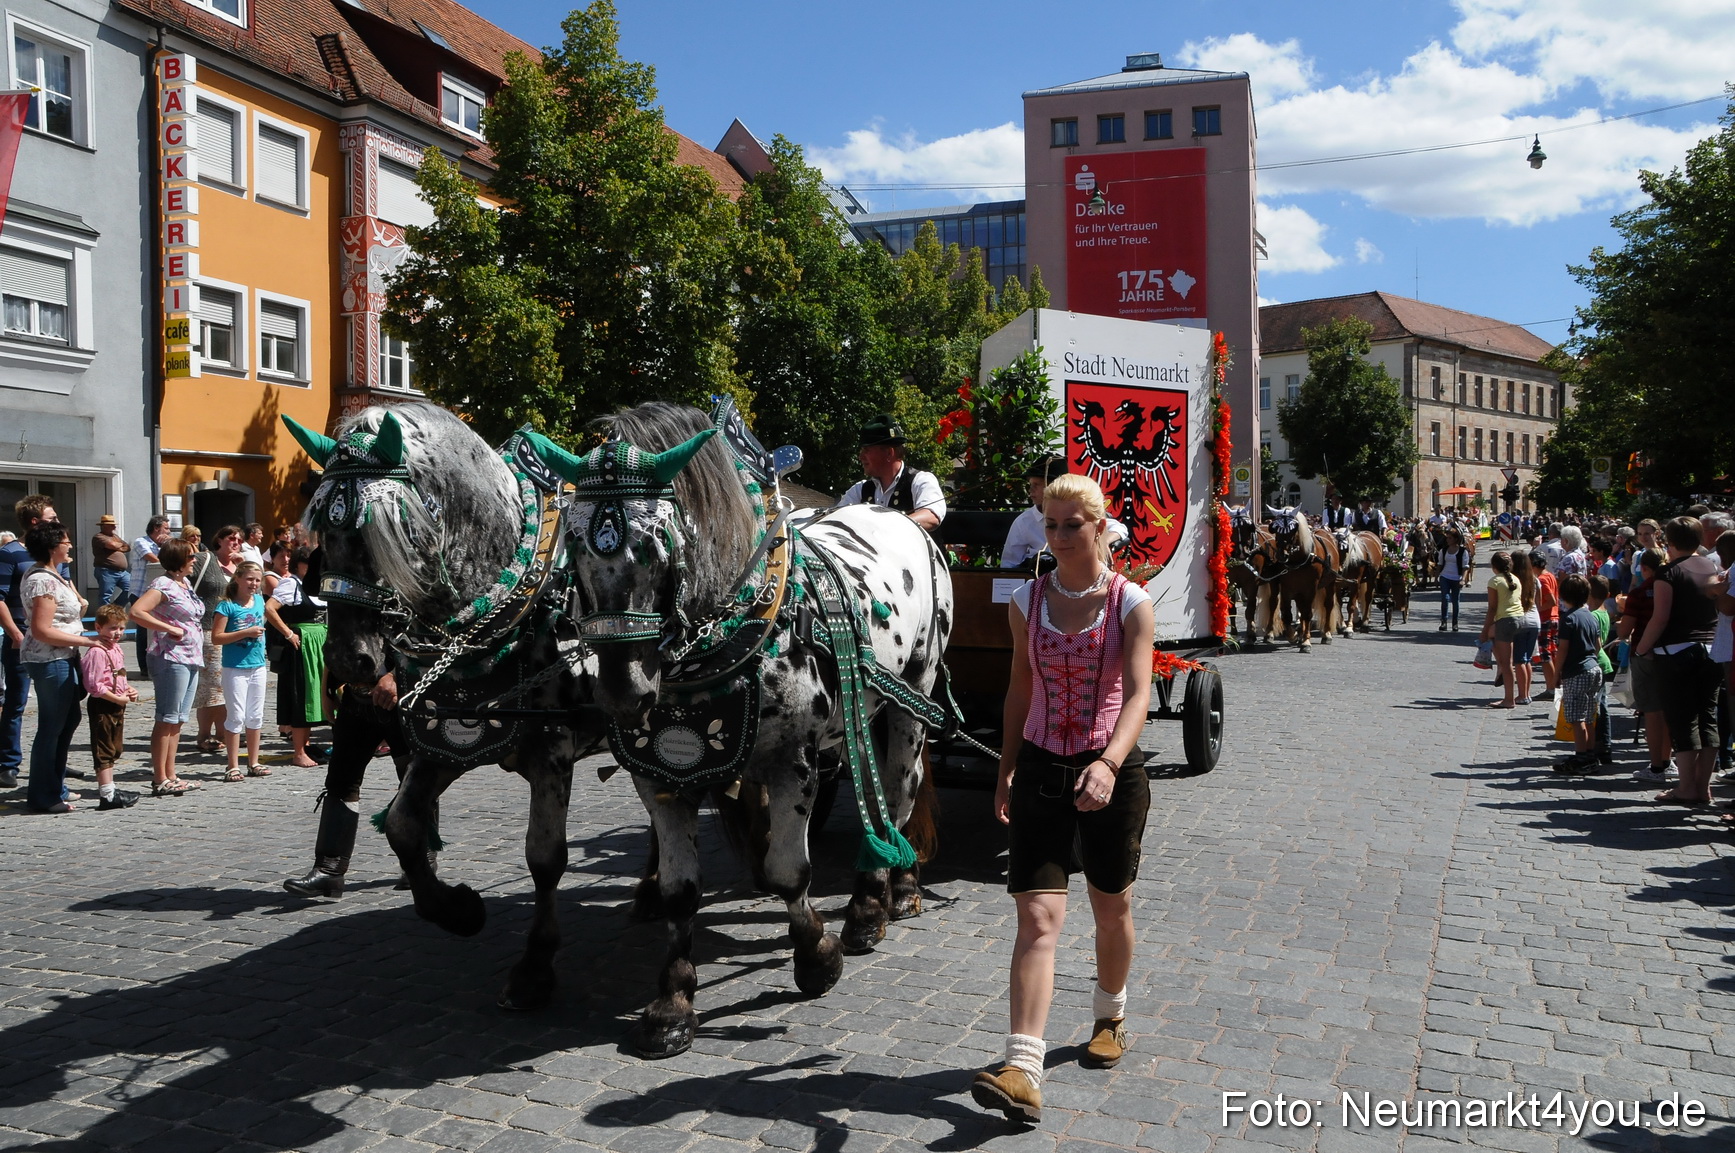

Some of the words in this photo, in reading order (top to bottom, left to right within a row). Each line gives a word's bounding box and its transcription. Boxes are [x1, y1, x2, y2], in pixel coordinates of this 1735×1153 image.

[164, 58, 185, 309] BÄCKEREI
[1075, 224, 1089, 234] für
[1092, 223, 1106, 233] Ihr
[1108, 222, 1158, 232] Vertrauen
[1075, 237, 1095, 247] und
[1098, 236, 1117, 246] Ihre
[1119, 235, 1151, 245] Treue.
[1117, 269, 1164, 290] 175
[1118, 289, 1164, 303] JAHRE
[165, 322, 190, 340] café
[165, 352, 190, 373] plank
[1064, 351, 1106, 377] Stadt
[1112, 356, 1190, 384] Neumarkt
